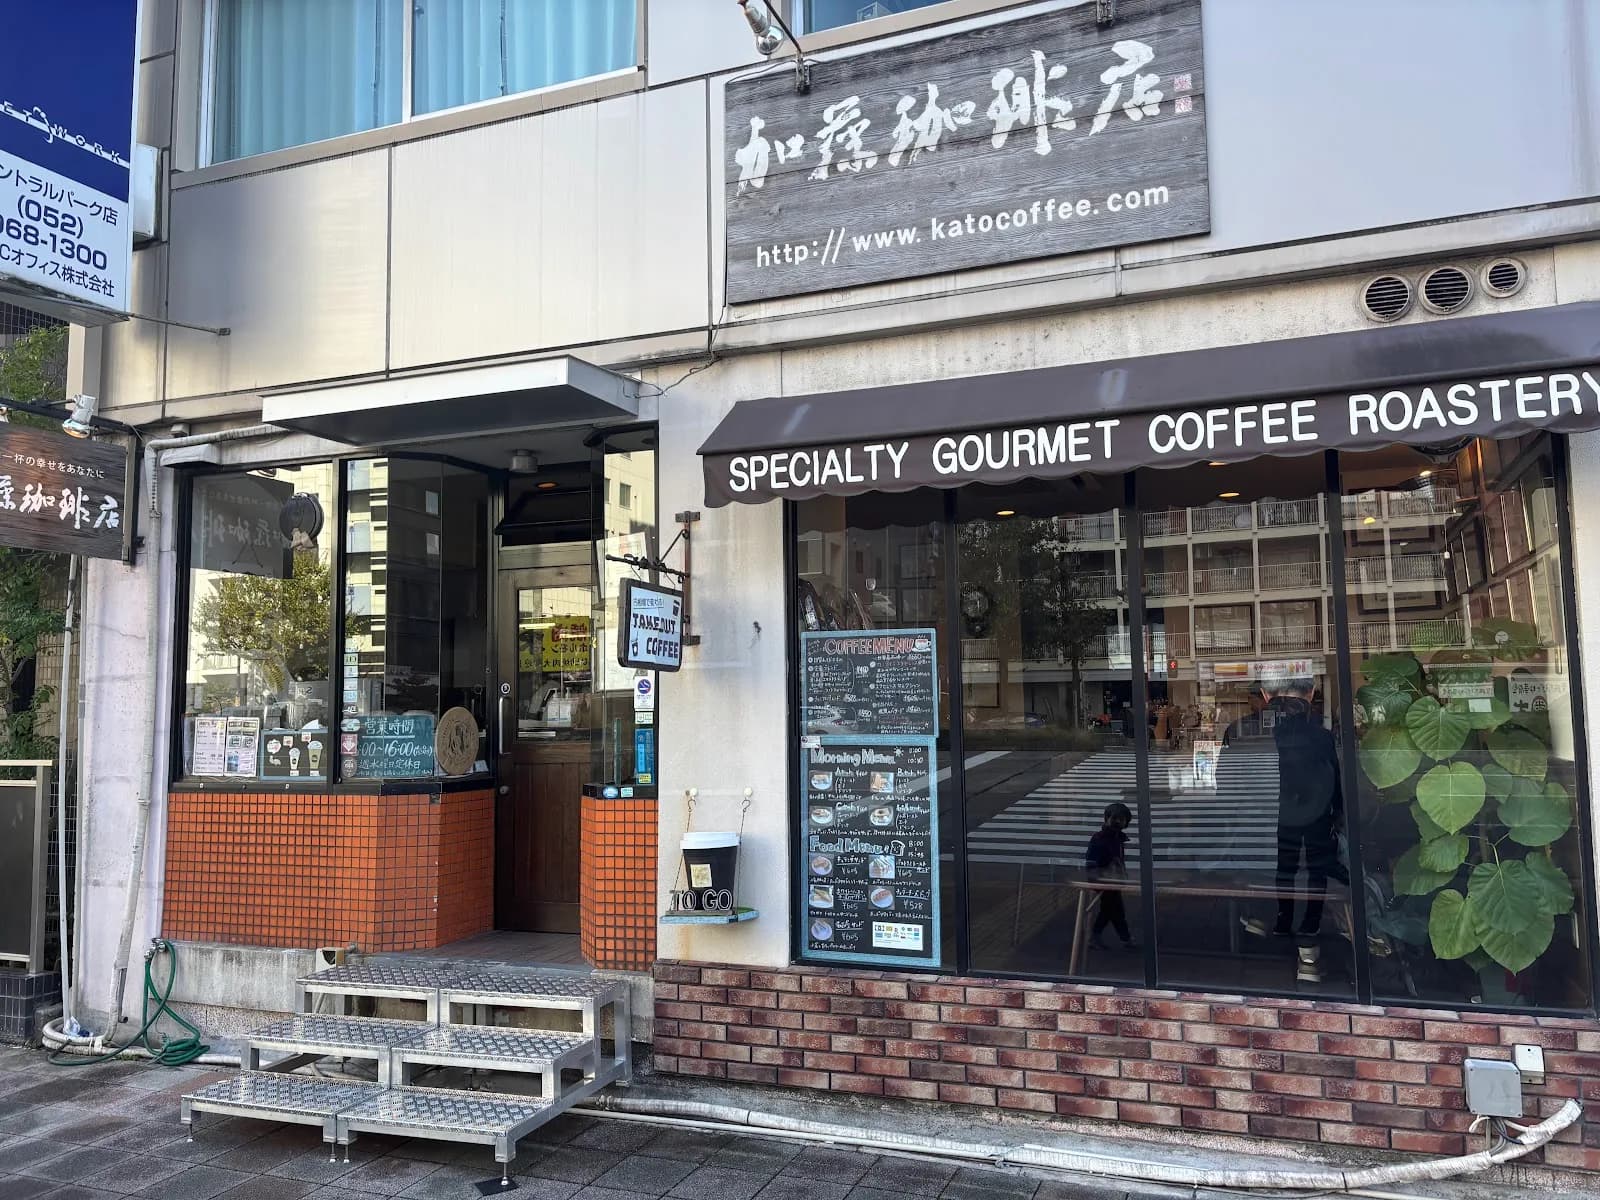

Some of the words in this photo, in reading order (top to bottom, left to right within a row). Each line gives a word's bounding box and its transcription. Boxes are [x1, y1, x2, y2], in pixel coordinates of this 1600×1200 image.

[18, 195, 84, 239] (052)
[729, 441, 909, 492] SPECIALTY
[932, 419, 1120, 474] GOURMET
[1148, 399, 1318, 453] COFFEE
[2, 453, 105, 479] 一杯の幸せをあなたに
[646, 637, 679, 659] COFFEE
[364, 717, 415, 735] 営業時間
[810, 747, 860, 766] Morning
[809, 835, 844, 853] Food
[669, 889, 697, 911] TO
[702, 888, 733, 911] GO
